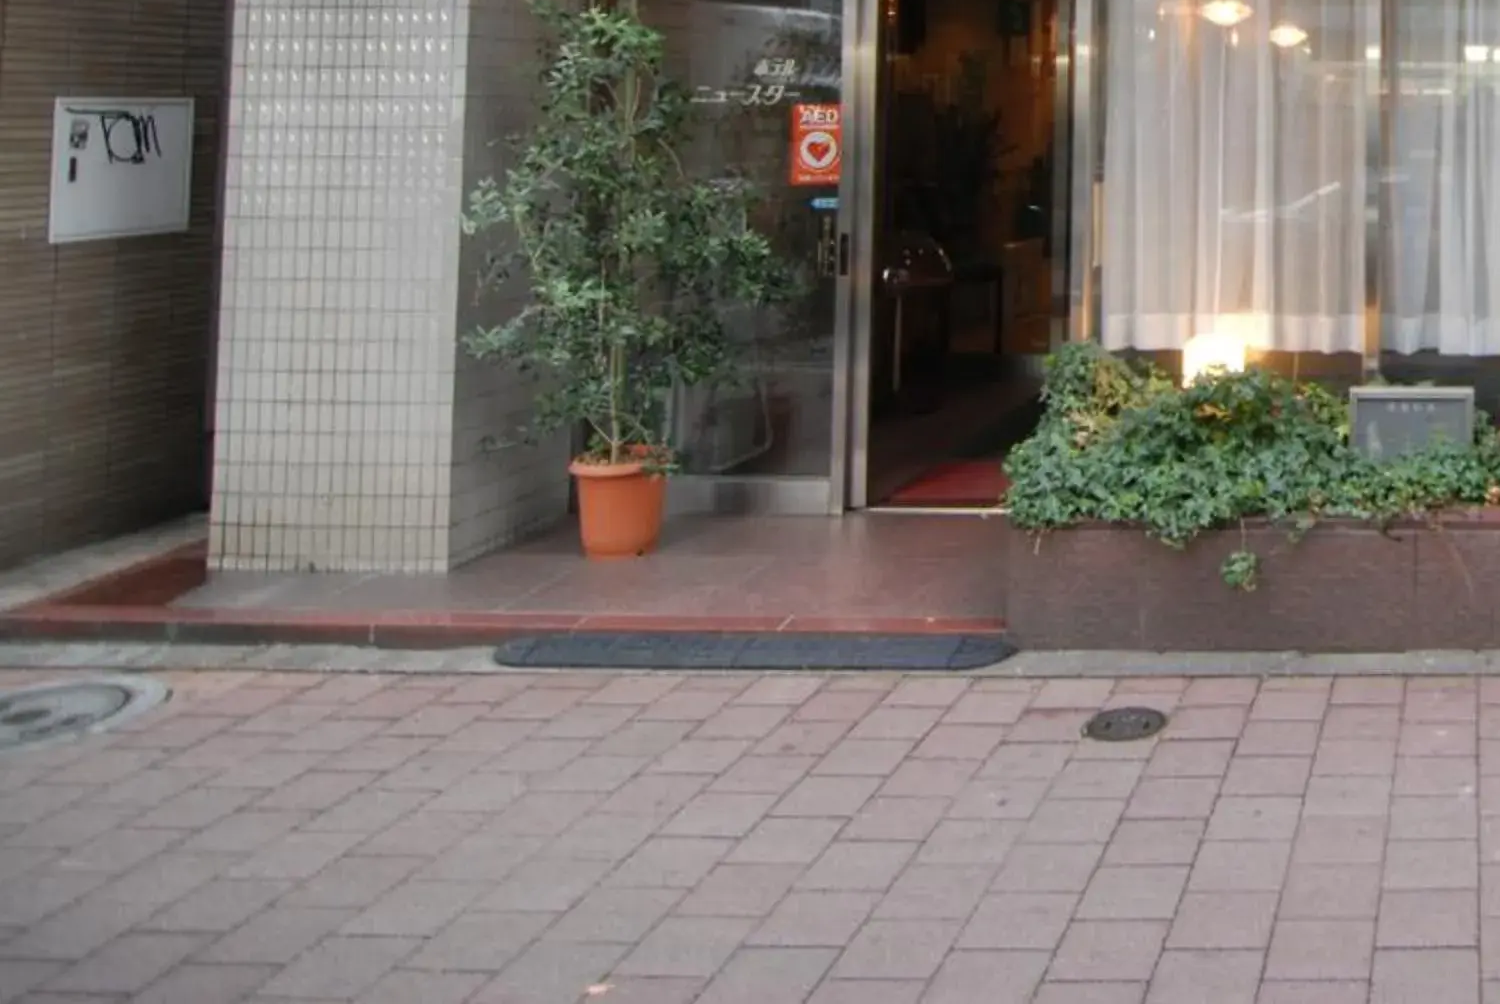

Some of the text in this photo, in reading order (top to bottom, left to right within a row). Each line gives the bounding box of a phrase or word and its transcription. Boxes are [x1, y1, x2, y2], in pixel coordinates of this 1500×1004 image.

[690, 84, 801, 106] ニュースター
